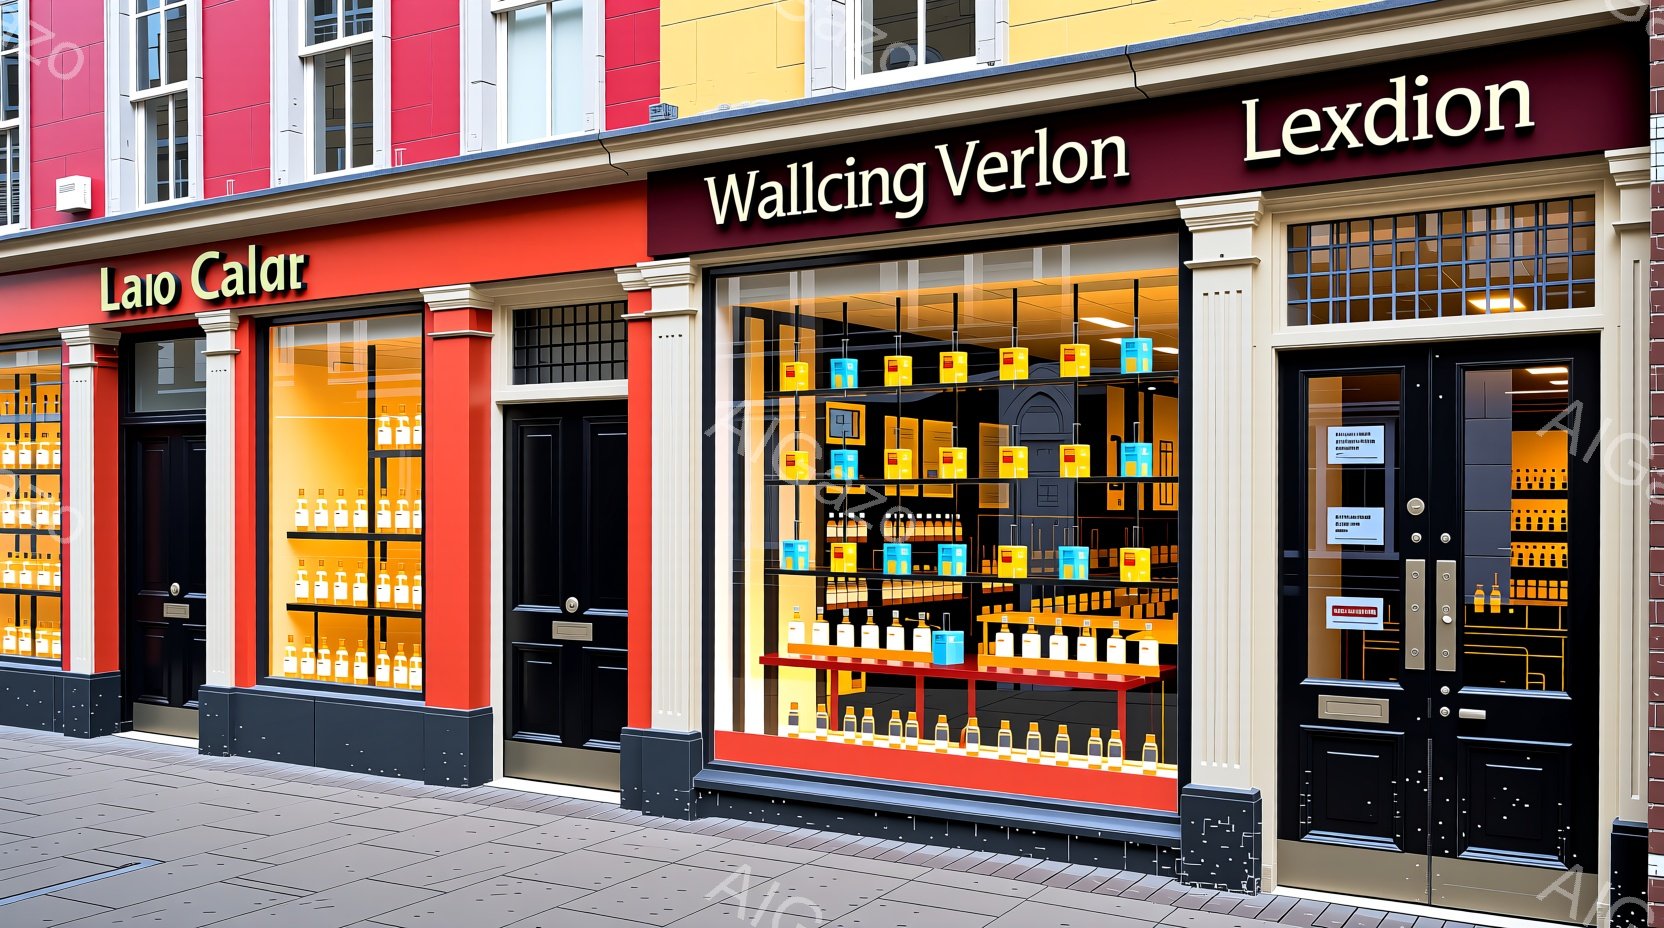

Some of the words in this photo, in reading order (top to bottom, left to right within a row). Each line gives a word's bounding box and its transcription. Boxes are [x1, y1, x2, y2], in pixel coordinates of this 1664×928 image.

[703, 156, 927, 226] Wallcing
[934, 127, 1130, 197] Verlon
[1241, 74, 1536, 162] Lexdion
